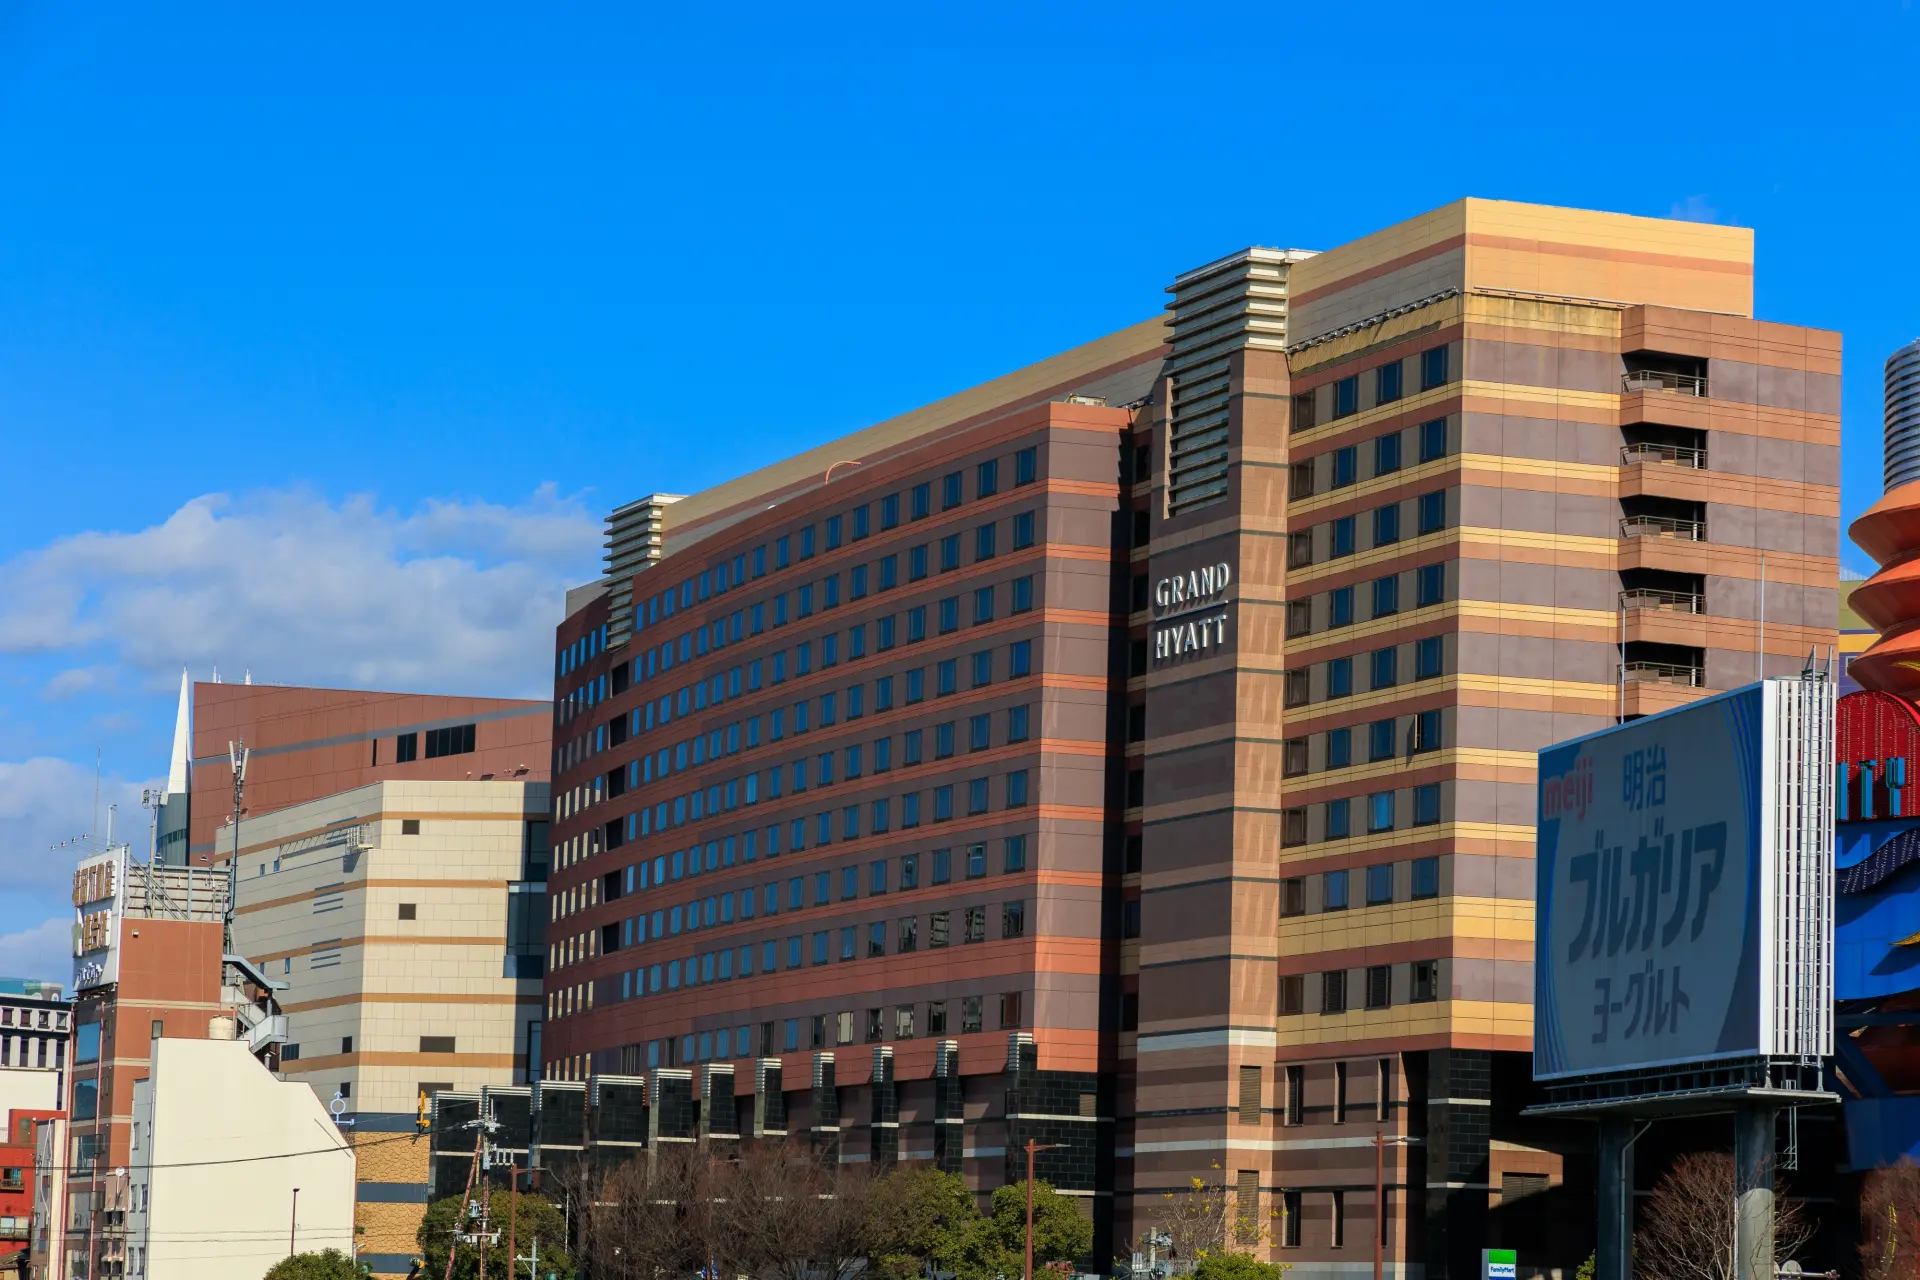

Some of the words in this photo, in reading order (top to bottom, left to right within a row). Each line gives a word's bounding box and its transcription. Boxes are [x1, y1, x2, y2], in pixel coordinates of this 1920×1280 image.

[1156, 562, 1230, 607] GRAND
[1156, 614, 1228, 659] HYATT
[1544, 756, 1593, 821] meiji
[1622, 743, 1667, 813] 明治
[1836, 756, 1906, 821] ITY
[1568, 816, 1728, 964] ブルガリア
[1591, 958, 1690, 1044] ヨーグルト
[1490, 1266, 1515, 1274] FamilyMart
